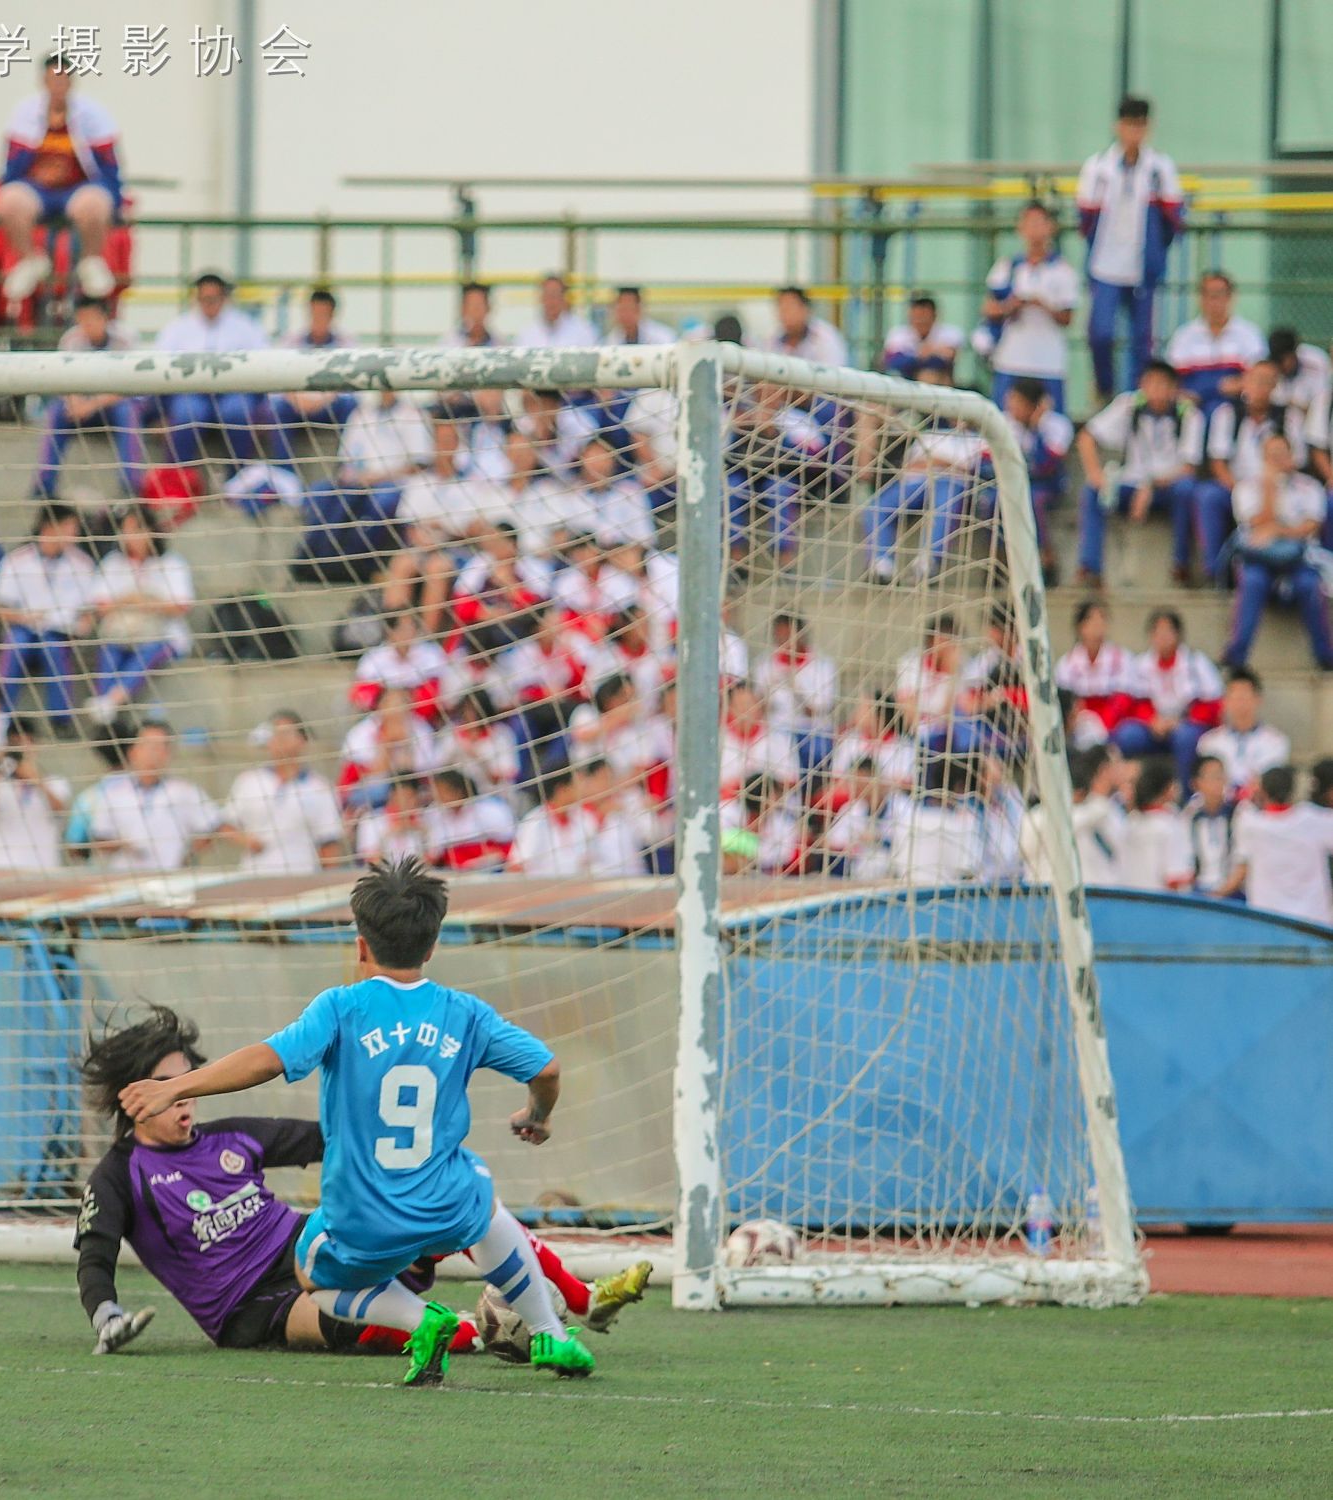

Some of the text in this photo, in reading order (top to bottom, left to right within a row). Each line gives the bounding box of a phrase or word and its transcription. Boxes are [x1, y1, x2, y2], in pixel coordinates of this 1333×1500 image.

[360, 1021, 462, 1060] 双十中学
[374, 1064, 438, 1170] 9
